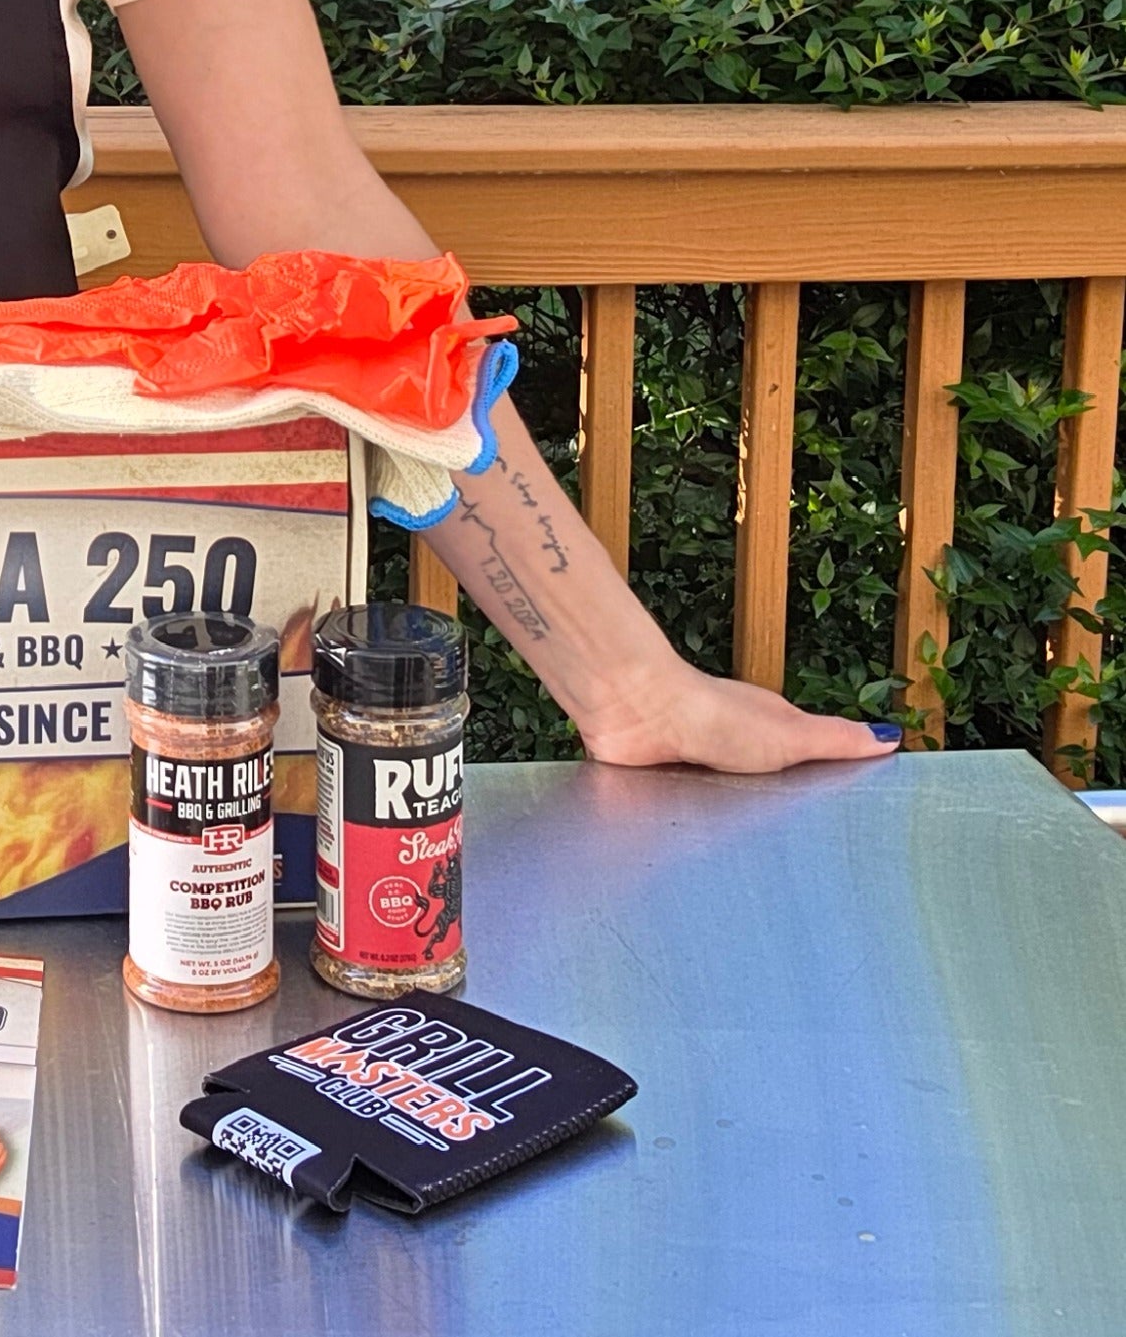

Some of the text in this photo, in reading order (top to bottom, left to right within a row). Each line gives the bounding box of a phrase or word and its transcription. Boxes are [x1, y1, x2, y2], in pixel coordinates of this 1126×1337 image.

[83, 532, 258, 623] 250
[17, 634, 83, 670] BBQ
[146, 755, 223, 800] HEATH
[373, 741, 463, 820] RUF
[178, 794, 261, 821] BBQ & GRILLING
[398, 827, 457, 865] Steak
[169, 869, 265, 895] COMPETITION
[192, 858, 252, 873] AUTHENTIC
[190, 890, 253, 911] BBQ RUB
[380, 895, 413, 909] BBQ
[333, 1008, 552, 1124] GRILL
[315, 1077, 387, 1119] CLUB
